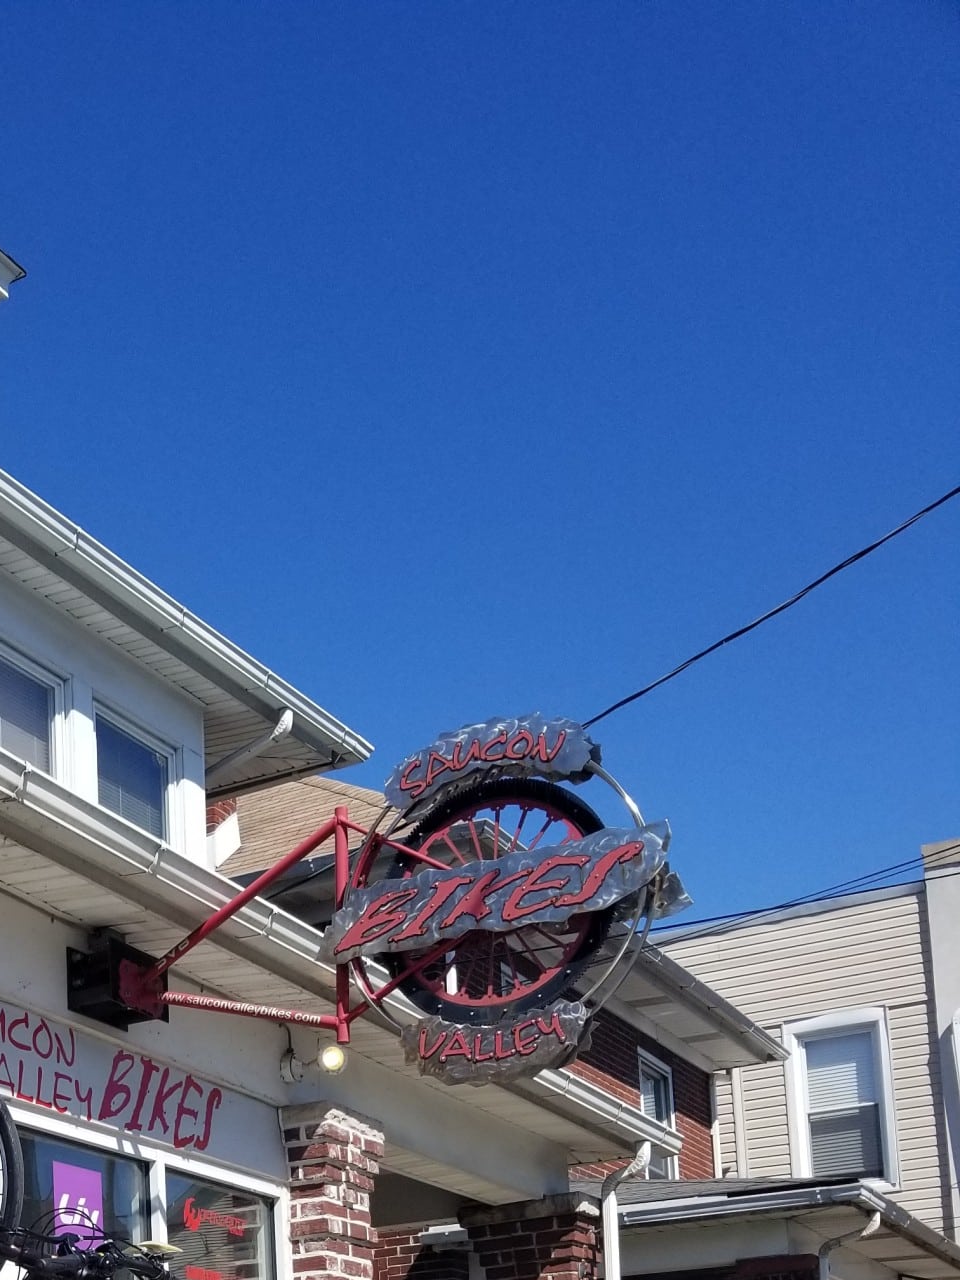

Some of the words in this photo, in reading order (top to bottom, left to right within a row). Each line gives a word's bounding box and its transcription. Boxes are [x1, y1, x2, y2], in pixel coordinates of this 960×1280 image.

[400, 729, 567, 798] SAUCON
[334, 842, 643, 954] BIKES
[419, 1012, 566, 1063] VALLEY
[99, 1049, 222, 1151] BIKES
[59, 1194, 99, 1228] Liv
